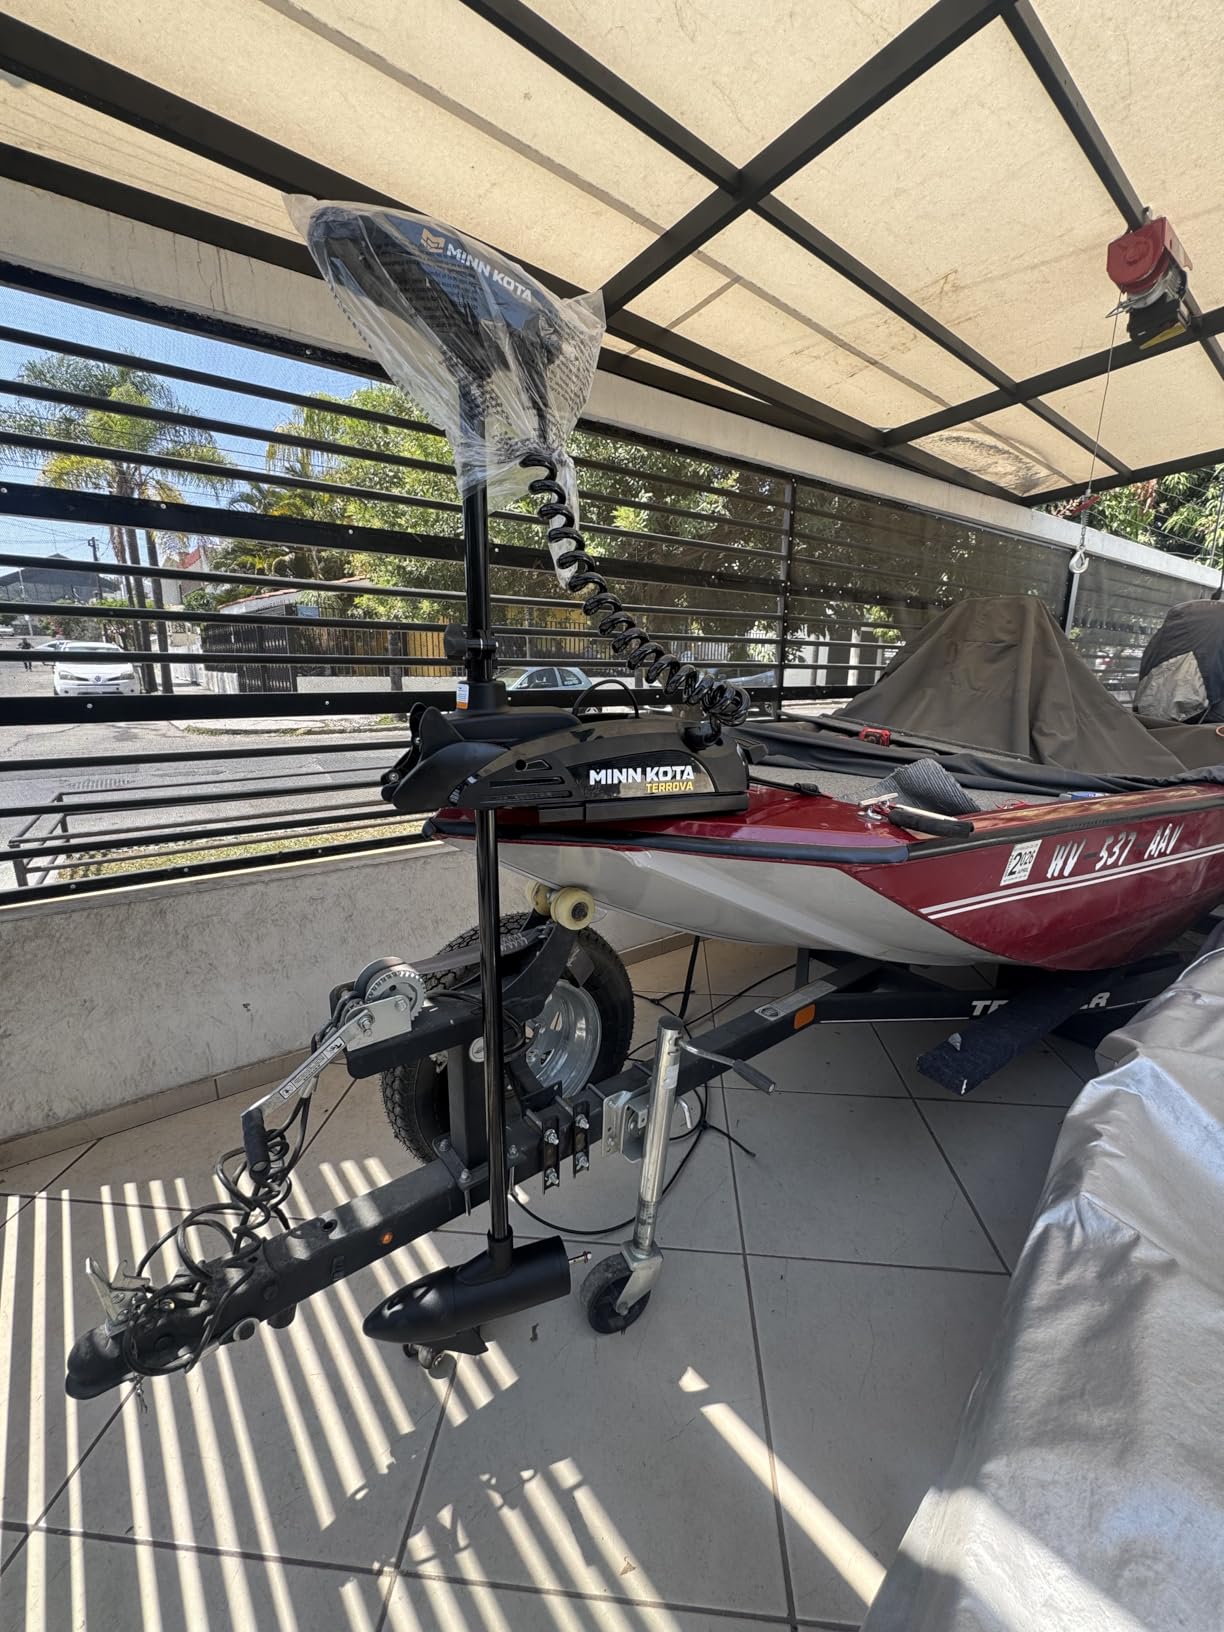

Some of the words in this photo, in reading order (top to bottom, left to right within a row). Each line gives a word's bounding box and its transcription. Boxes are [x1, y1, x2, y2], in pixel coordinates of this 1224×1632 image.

[446, 243, 491, 278] MINN
[492, 269, 532, 302] KOTA
[589, 767, 642, 785] MINN
[646, 765, 695, 782] KOTA
[646, 781, 694, 793] TERROVA
[1095, 831, 1137, 871] 537
